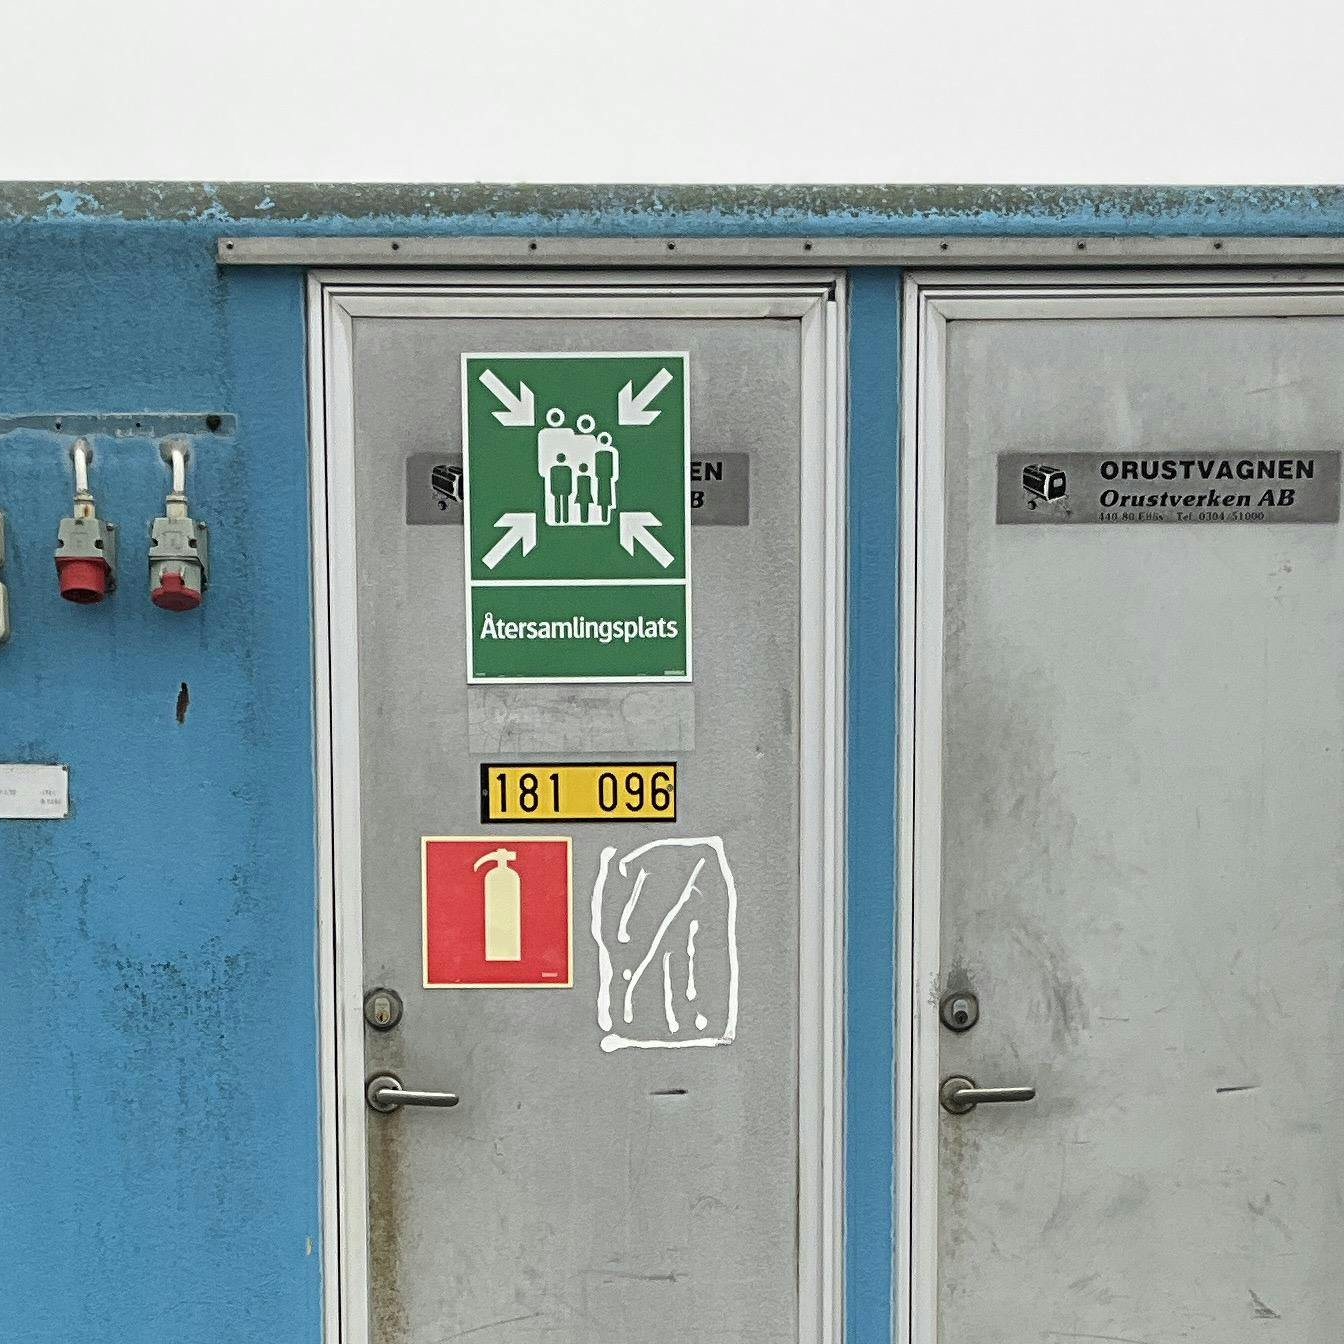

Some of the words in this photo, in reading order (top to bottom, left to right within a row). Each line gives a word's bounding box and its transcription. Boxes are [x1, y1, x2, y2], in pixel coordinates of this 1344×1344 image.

[1099, 459, 1315, 480] ORUSTVAGNEN
[1098, 488, 1252, 508] Orustverken
[1257, 488, 1297, 507] AB
[479, 611, 680, 643] Återsamlingsplats
[496, 773, 560, 813] 181
[598, 771, 672, 812] 096
